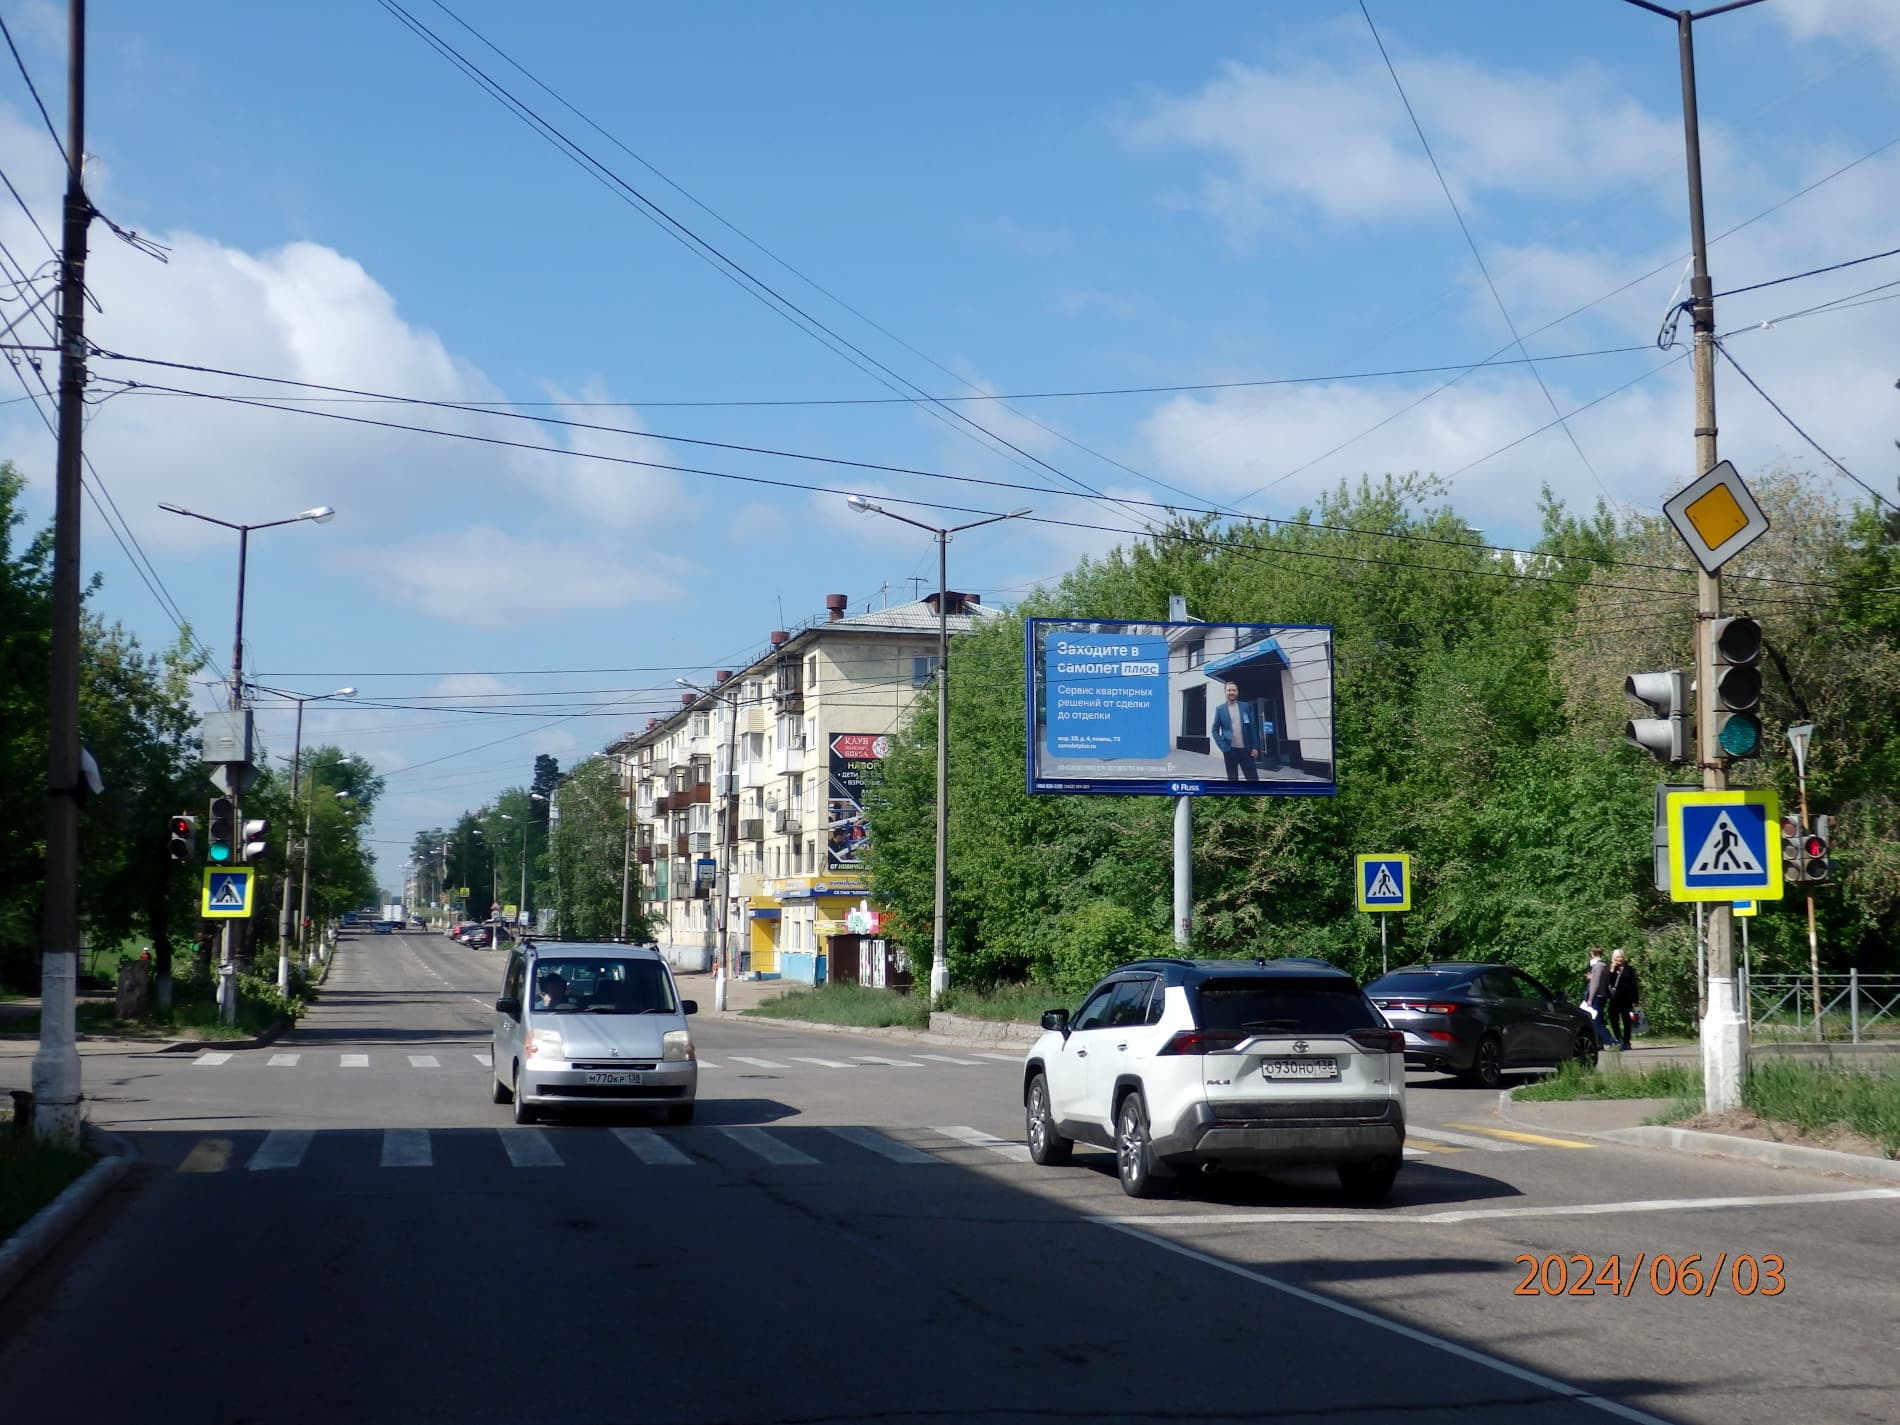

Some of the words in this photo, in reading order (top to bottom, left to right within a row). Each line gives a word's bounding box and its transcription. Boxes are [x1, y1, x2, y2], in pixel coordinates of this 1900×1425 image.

[1057, 641, 1128, 658] Заходите
[1131, 647, 1140, 657] в
[1057, 663, 1119, 674] самолет
[1123, 664, 1157, 675] плюс
[1057, 685, 1094, 696] Сервис
[1095, 687, 1153, 697] квартирных
[1057, 698, 1101, 708] решений
[1103, 700, 1114, 708] от
[1116, 700, 1150, 710] сделки
[1057, 711, 1070, 720] до
[1072, 712, 1111, 721] отделки
[844, 737, 869, 745] КЛУБ
[1180, 783, 1200, 792] Russ
